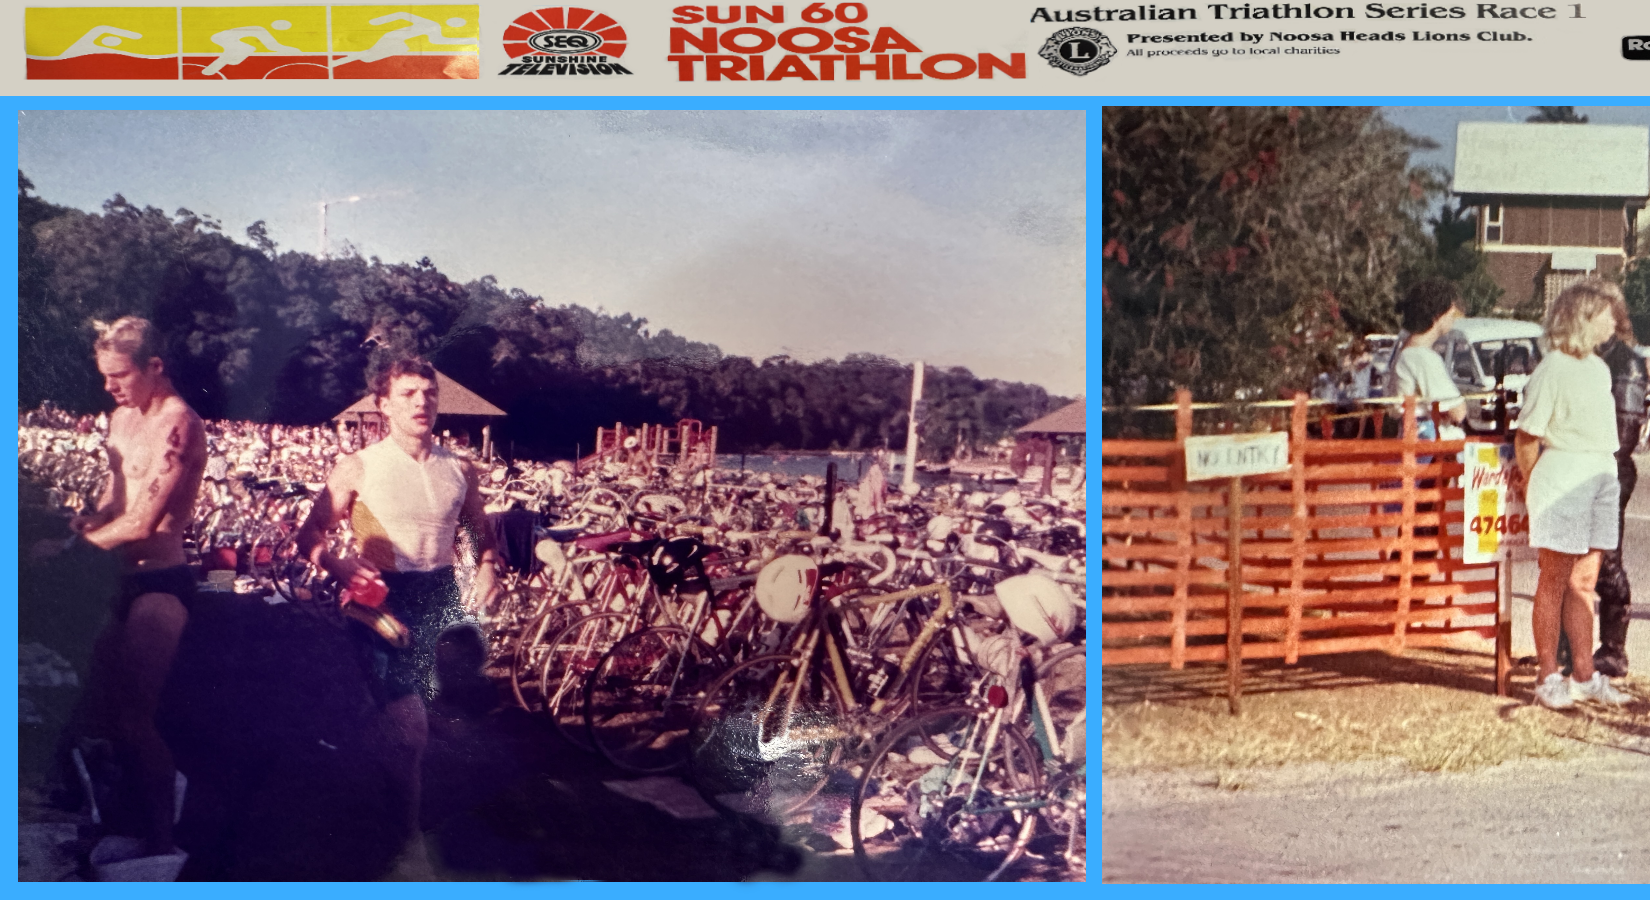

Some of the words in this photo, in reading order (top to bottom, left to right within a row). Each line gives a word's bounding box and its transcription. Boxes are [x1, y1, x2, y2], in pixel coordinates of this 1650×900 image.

[672, 5, 784, 25] SUN
[801, 3, 868, 24] 60
[1030, 5, 1197, 23] Australian
[1207, 3, 1355, 20] Triathlon
[1365, 3, 1466, 19] Series
[1477, 3, 1556, 19] Race
[1568, 3, 1587, 19] 1
[543, 35, 588, 48] SEQ
[669, 26, 923, 54] NOOSA
[1127, 31, 1233, 43] Presented
[1240, 31, 1264, 44] by
[1270, 31, 1334, 42] Noosa
[1340, 31, 1406, 42] Heads
[1413, 30, 1471, 42] Lions
[1477, 30, 1533, 42] Club.
[521, 55, 607, 63] SUNSHINE
[1069, 41, 1090, 59] L
[1126, 48, 1143, 57] All
[1147, 48, 1208, 58] proceeds
[1212, 49, 1228, 58] go
[1232, 47, 1245, 56] to
[1249, 46, 1280, 55] local
[1284, 46, 1340, 55] charities
[498, 63, 634, 75] TELEVISION
[667, 52, 1027, 82] TRIATHLON
[1198, 452, 1219, 467] NO
[1227, 446, 1280, 466] ENTRY
